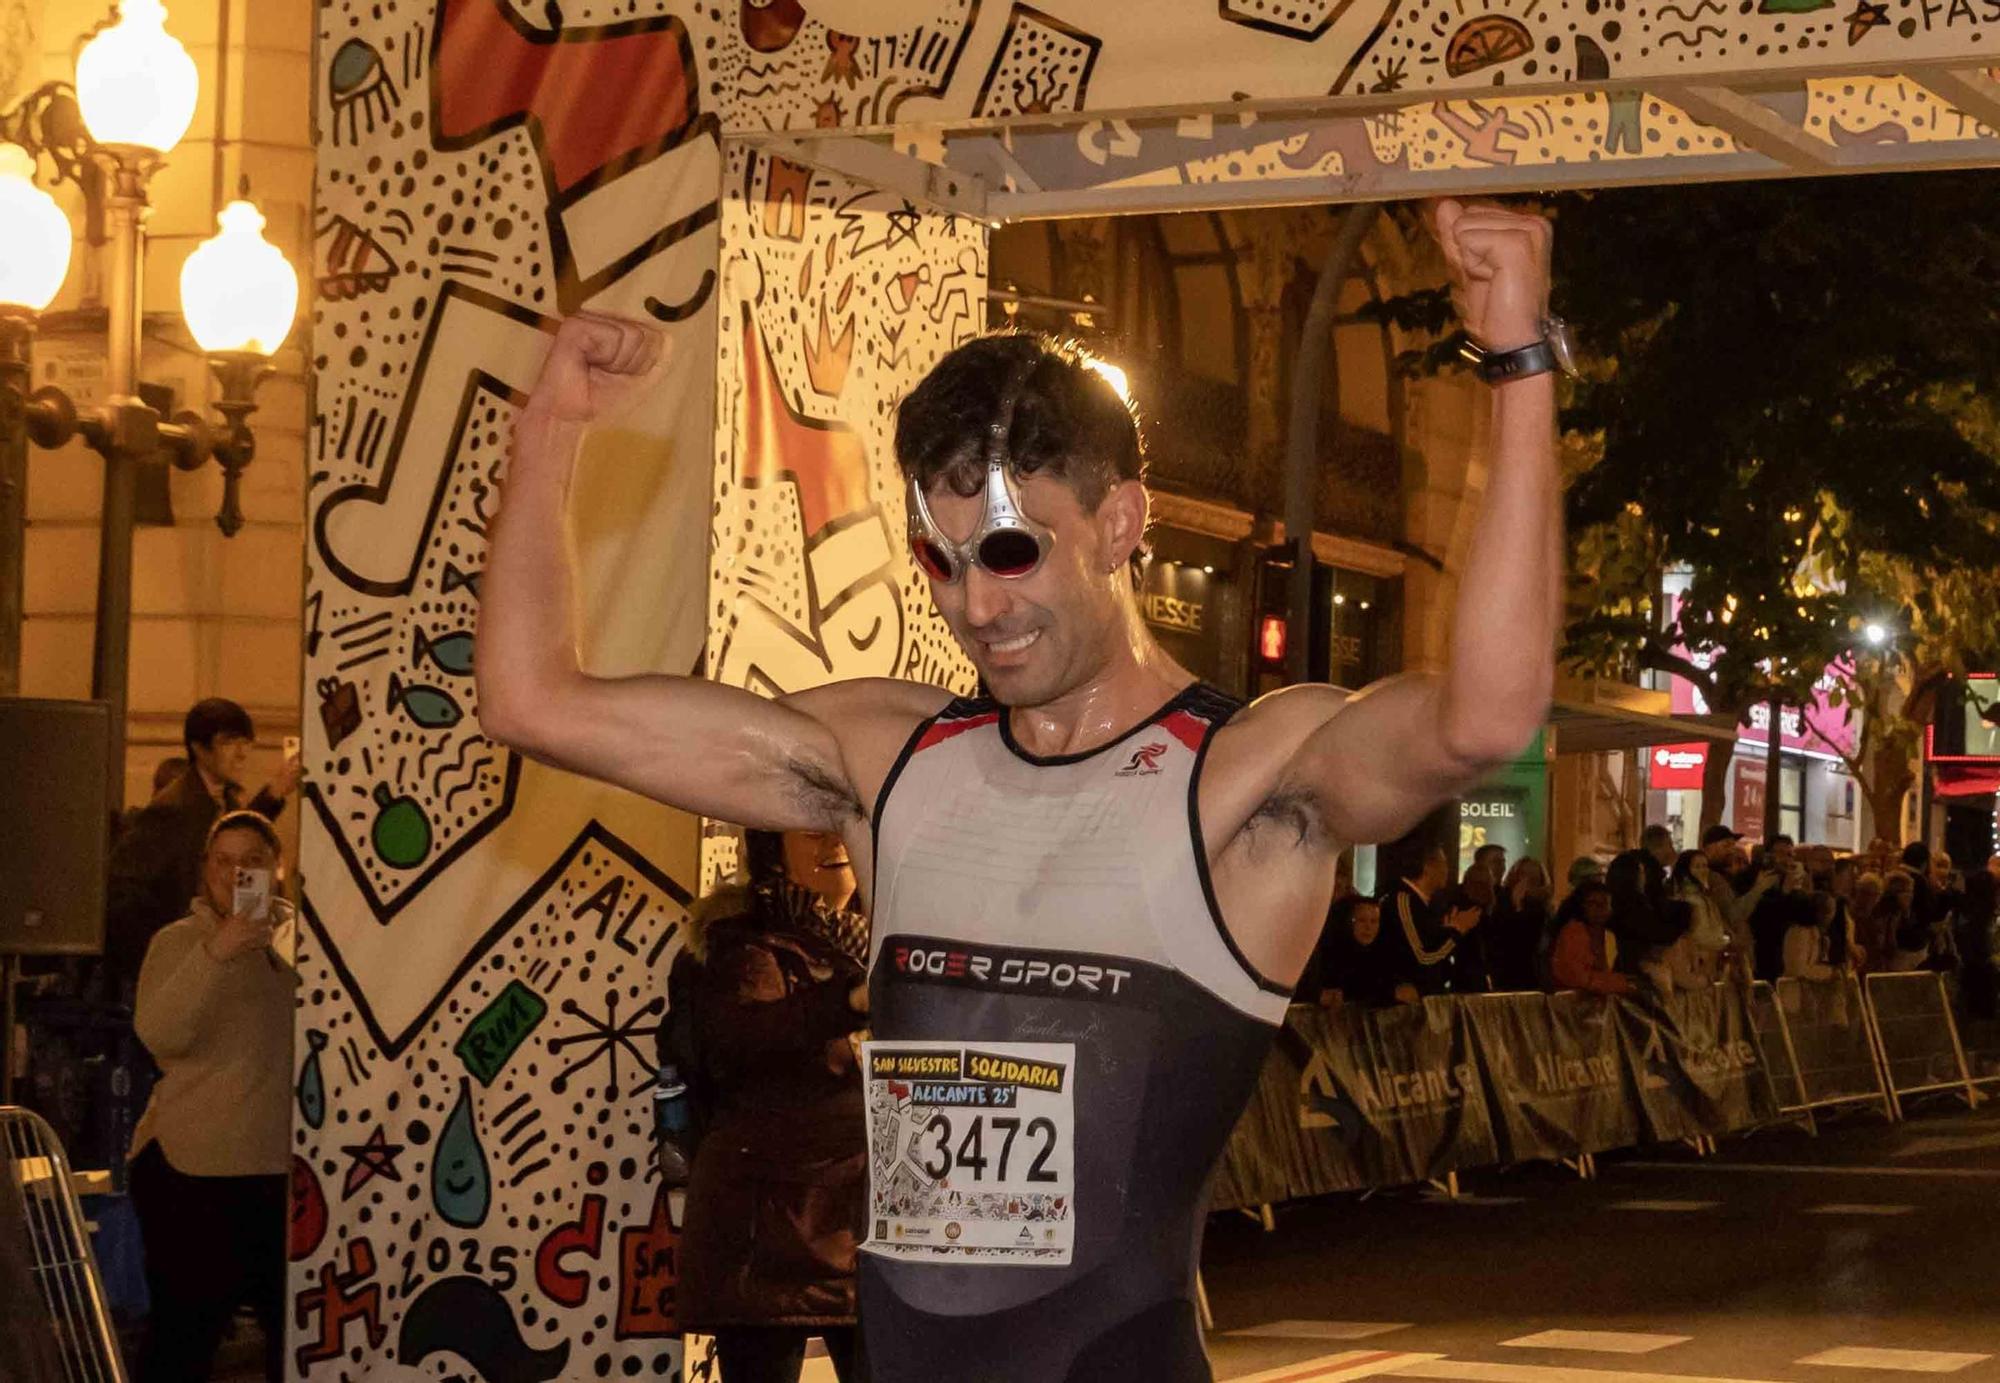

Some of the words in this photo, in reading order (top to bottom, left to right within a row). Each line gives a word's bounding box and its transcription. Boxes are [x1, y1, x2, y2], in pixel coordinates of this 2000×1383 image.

[1460, 802, 1514, 817] SOLEIL
[571, 875, 678, 968] ALI
[896, 947, 992, 981] ROGER
[1000, 959, 1131, 995] SPORT
[467, 992, 531, 1074] RUN
[873, 1056, 896, 1073] SAN
[898, 1056, 959, 1074] SILVESTRE
[970, 1056, 1060, 1088] SOLIDARIA
[913, 1083, 987, 1102] ALICANTE
[925, 1114, 1059, 1183] 3472
[401, 1237, 518, 1298] 2025
